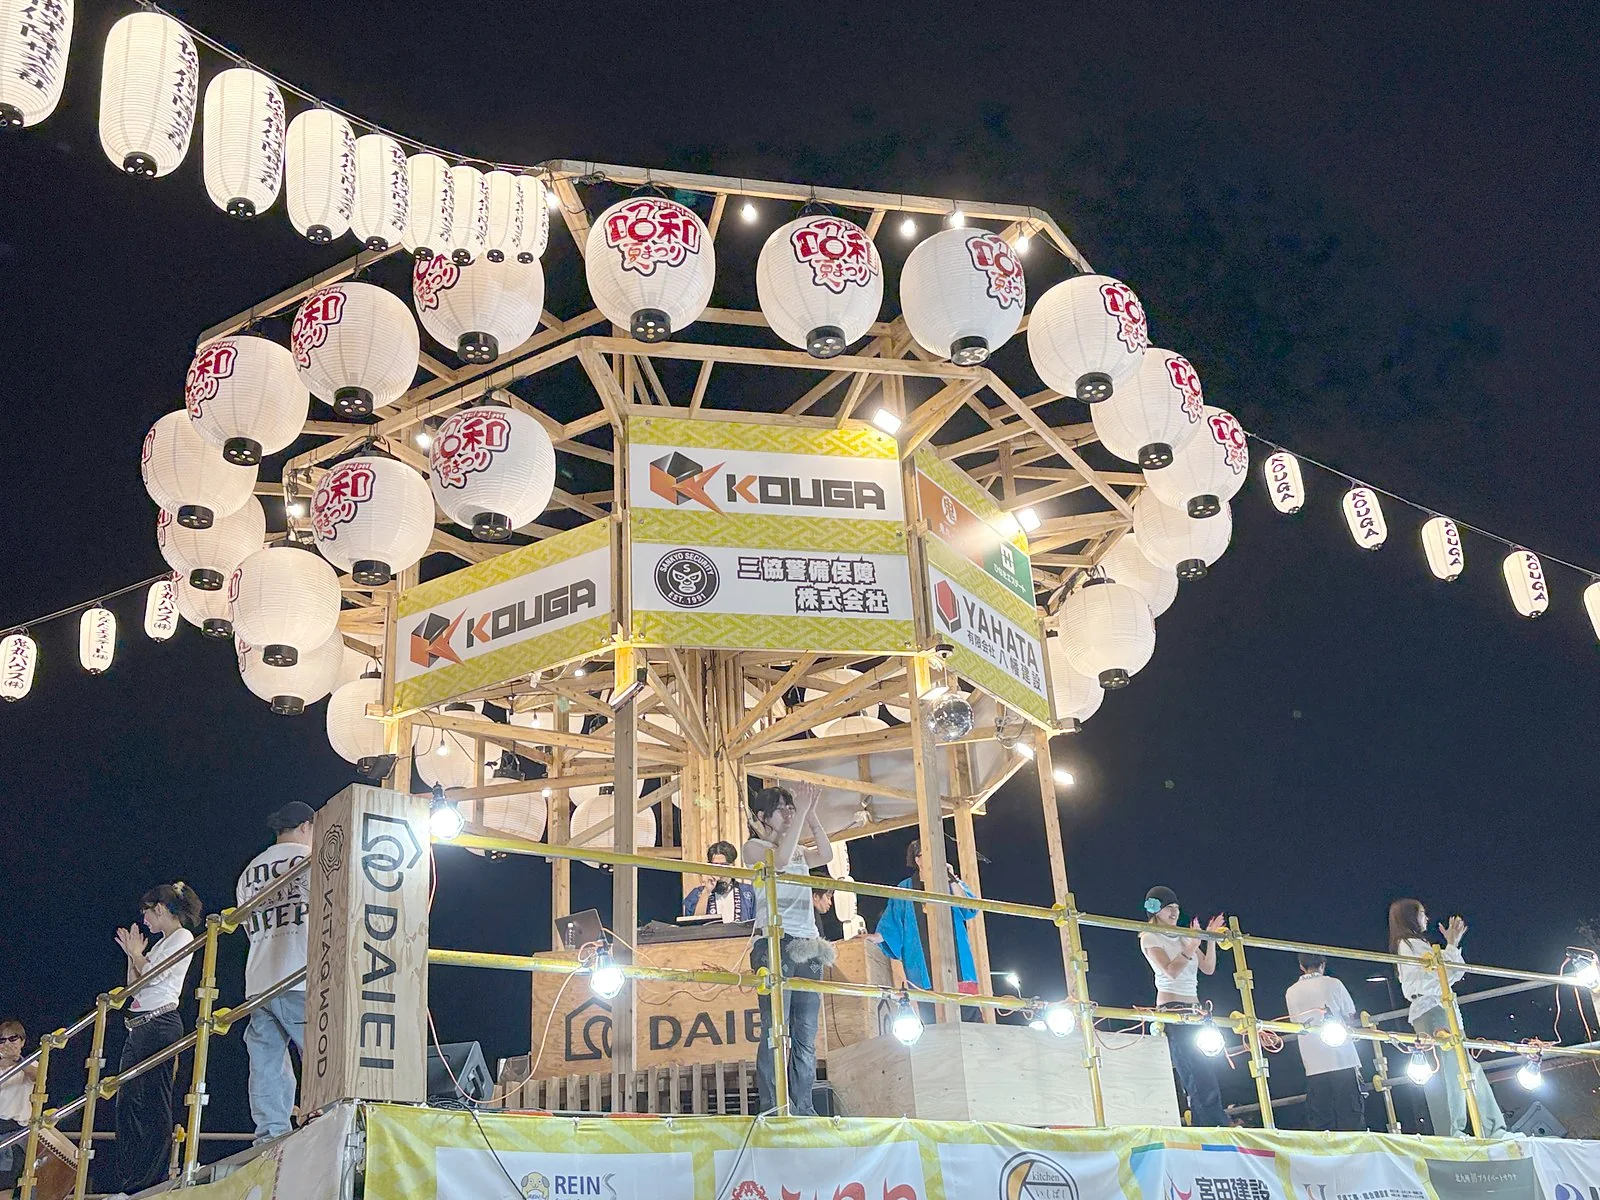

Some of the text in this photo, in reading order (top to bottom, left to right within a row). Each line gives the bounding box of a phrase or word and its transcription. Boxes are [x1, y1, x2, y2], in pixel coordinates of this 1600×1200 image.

[608, 202, 698, 249] 昭和
[622, 241, 681, 270] 夏まつり
[814, 259, 868, 288] 夏まつり
[726, 473, 886, 511] KOUGA
[1271, 456, 1295, 503] KOUGA
[1352, 490, 1379, 540] KOUGA
[1445, 521, 1461, 566] KOUGA
[660, 552, 714, 575] SANKYO SECURITY
[683, 564, 691, 572] S
[737, 555, 877, 585] 三協警備保障
[1526, 554, 1546, 602] KOUGA
[466, 578, 597, 649] KOUGA
[668, 591, 706, 604] EST. 1991
[796, 585, 889, 614] 株式会社
[963, 595, 1039, 674] YAHATA
[967, 629, 996, 660] 有限会社
[360, 903, 398, 1070] DAIEI
[650, 1008, 761, 1051] DAIE
[1032, 1171, 1060, 1182] kitchen
[1195, 1177, 1271, 1200] 宮田建設
